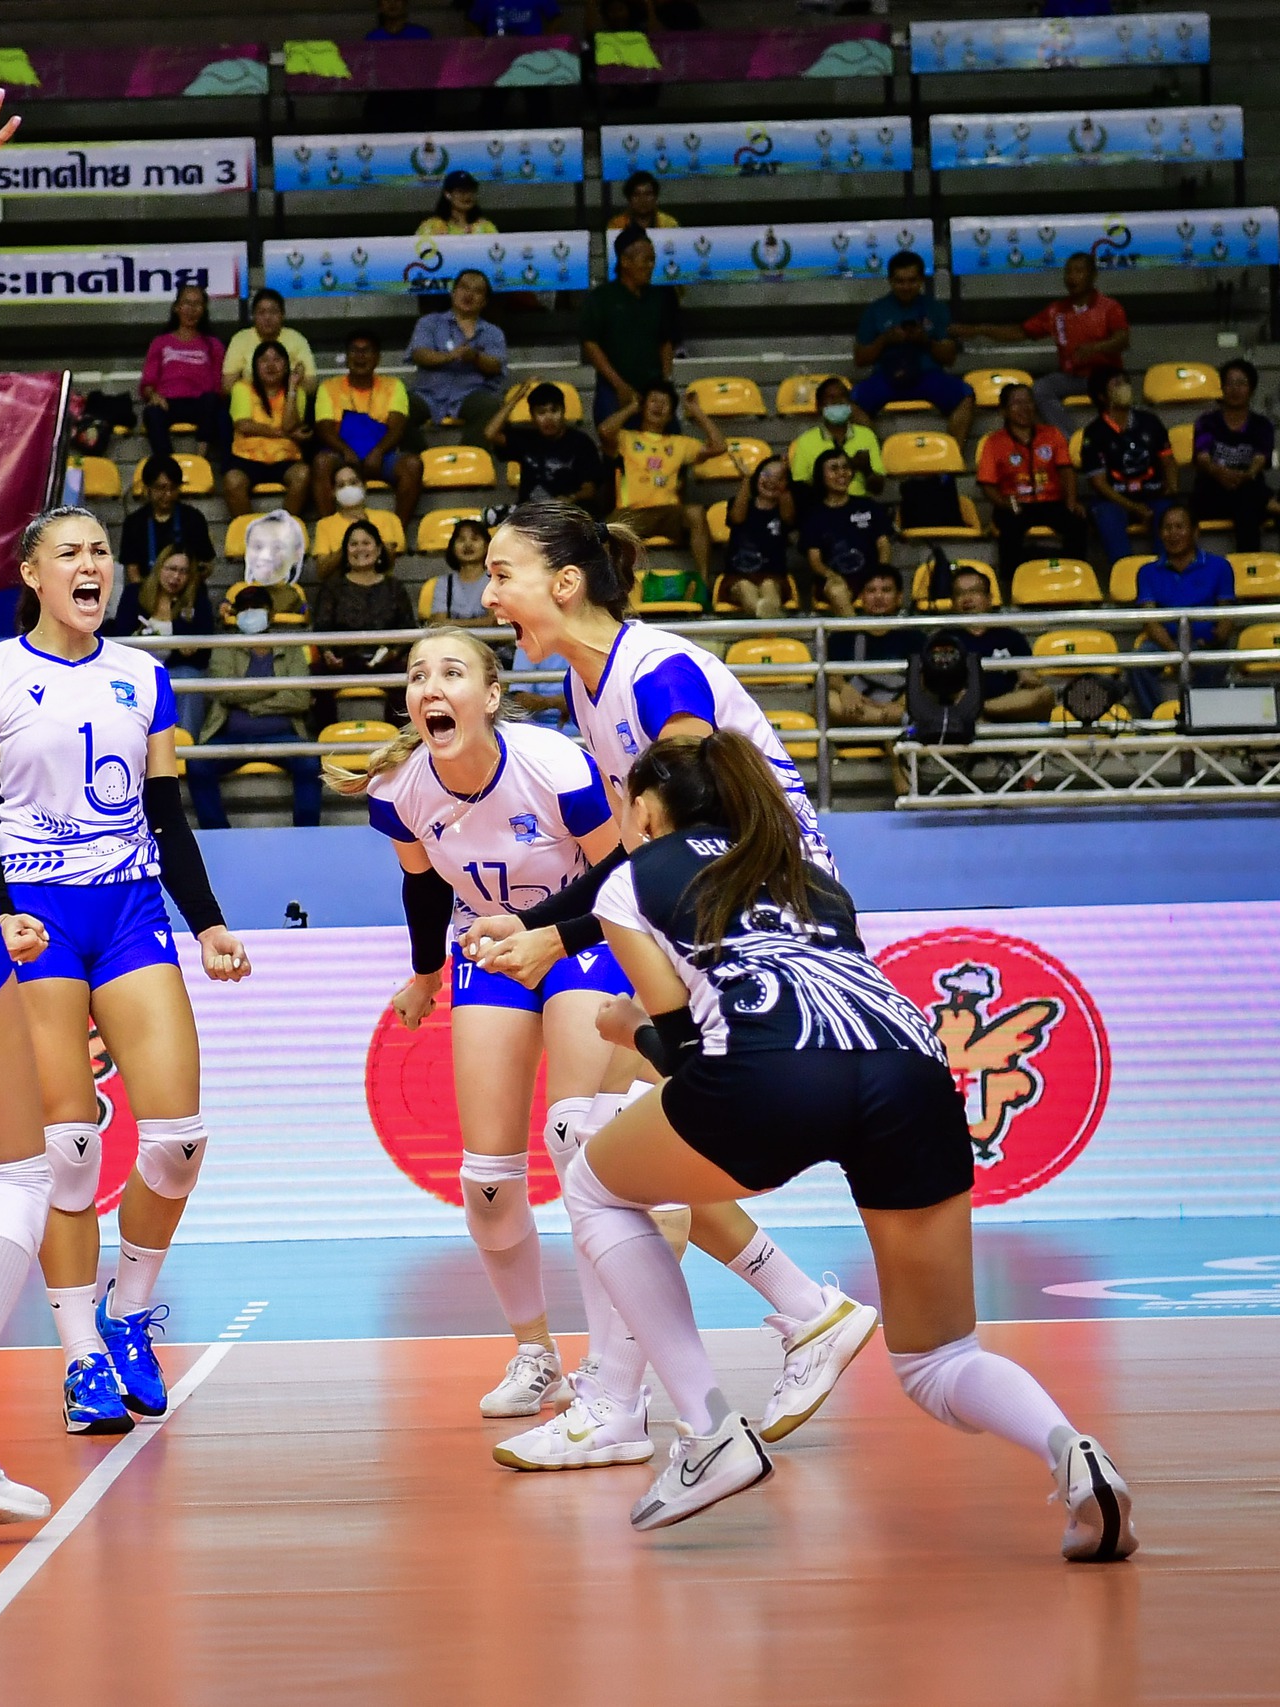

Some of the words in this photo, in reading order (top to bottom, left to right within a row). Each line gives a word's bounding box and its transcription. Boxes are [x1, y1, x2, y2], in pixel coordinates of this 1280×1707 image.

[143, 161, 204, 186] ภาค
[216, 159, 237, 184] 3
[685, 838, 738, 857] BEK
[461, 861, 510, 903] 17
[456, 962, 473, 990] 17
